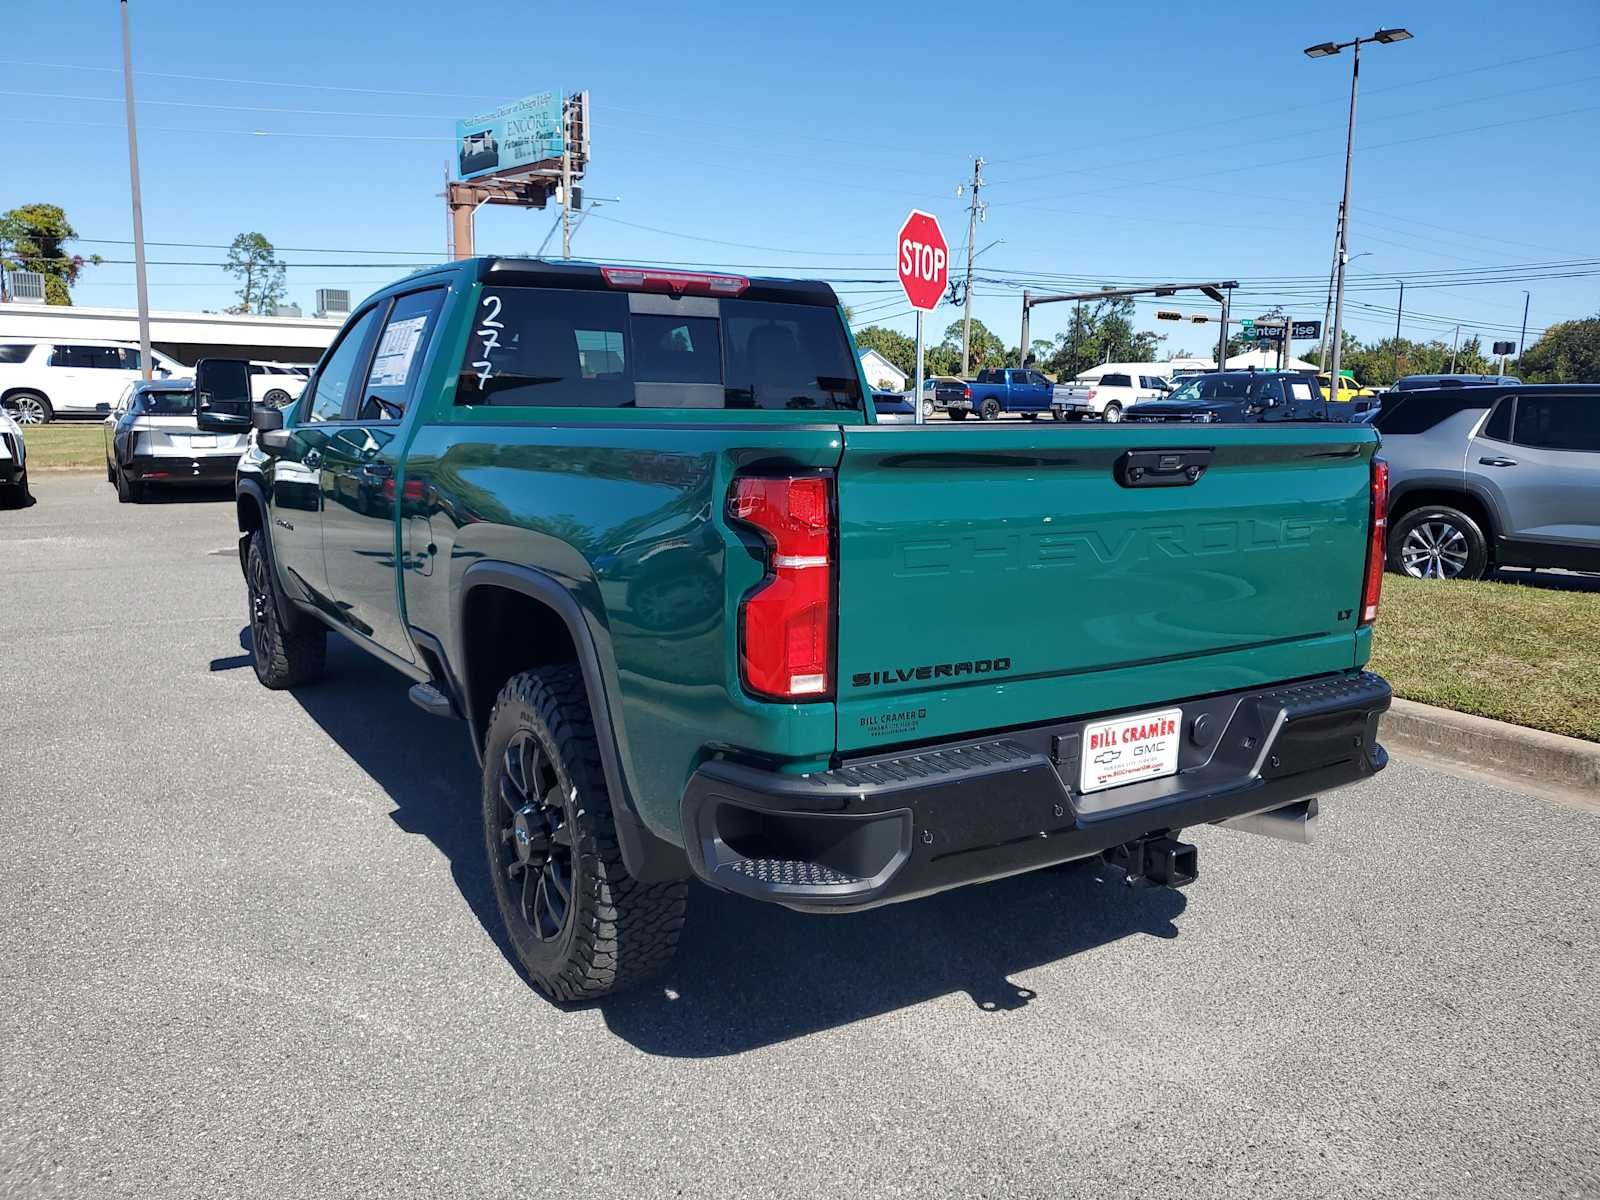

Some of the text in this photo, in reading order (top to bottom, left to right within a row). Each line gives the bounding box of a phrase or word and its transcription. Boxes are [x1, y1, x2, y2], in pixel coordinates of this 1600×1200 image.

[507, 112, 548, 136] ENCORE
[901, 239, 945, 283] STOP
[1337, 609, 1354, 622] LT
[852, 657, 1011, 687] SILVERADO
[860, 716, 878, 726] BILL
[880, 710, 917, 724] CRAMER
[1090, 720, 1175, 750] BILL CRAMER
[1133, 741, 1166, 756] GMC
